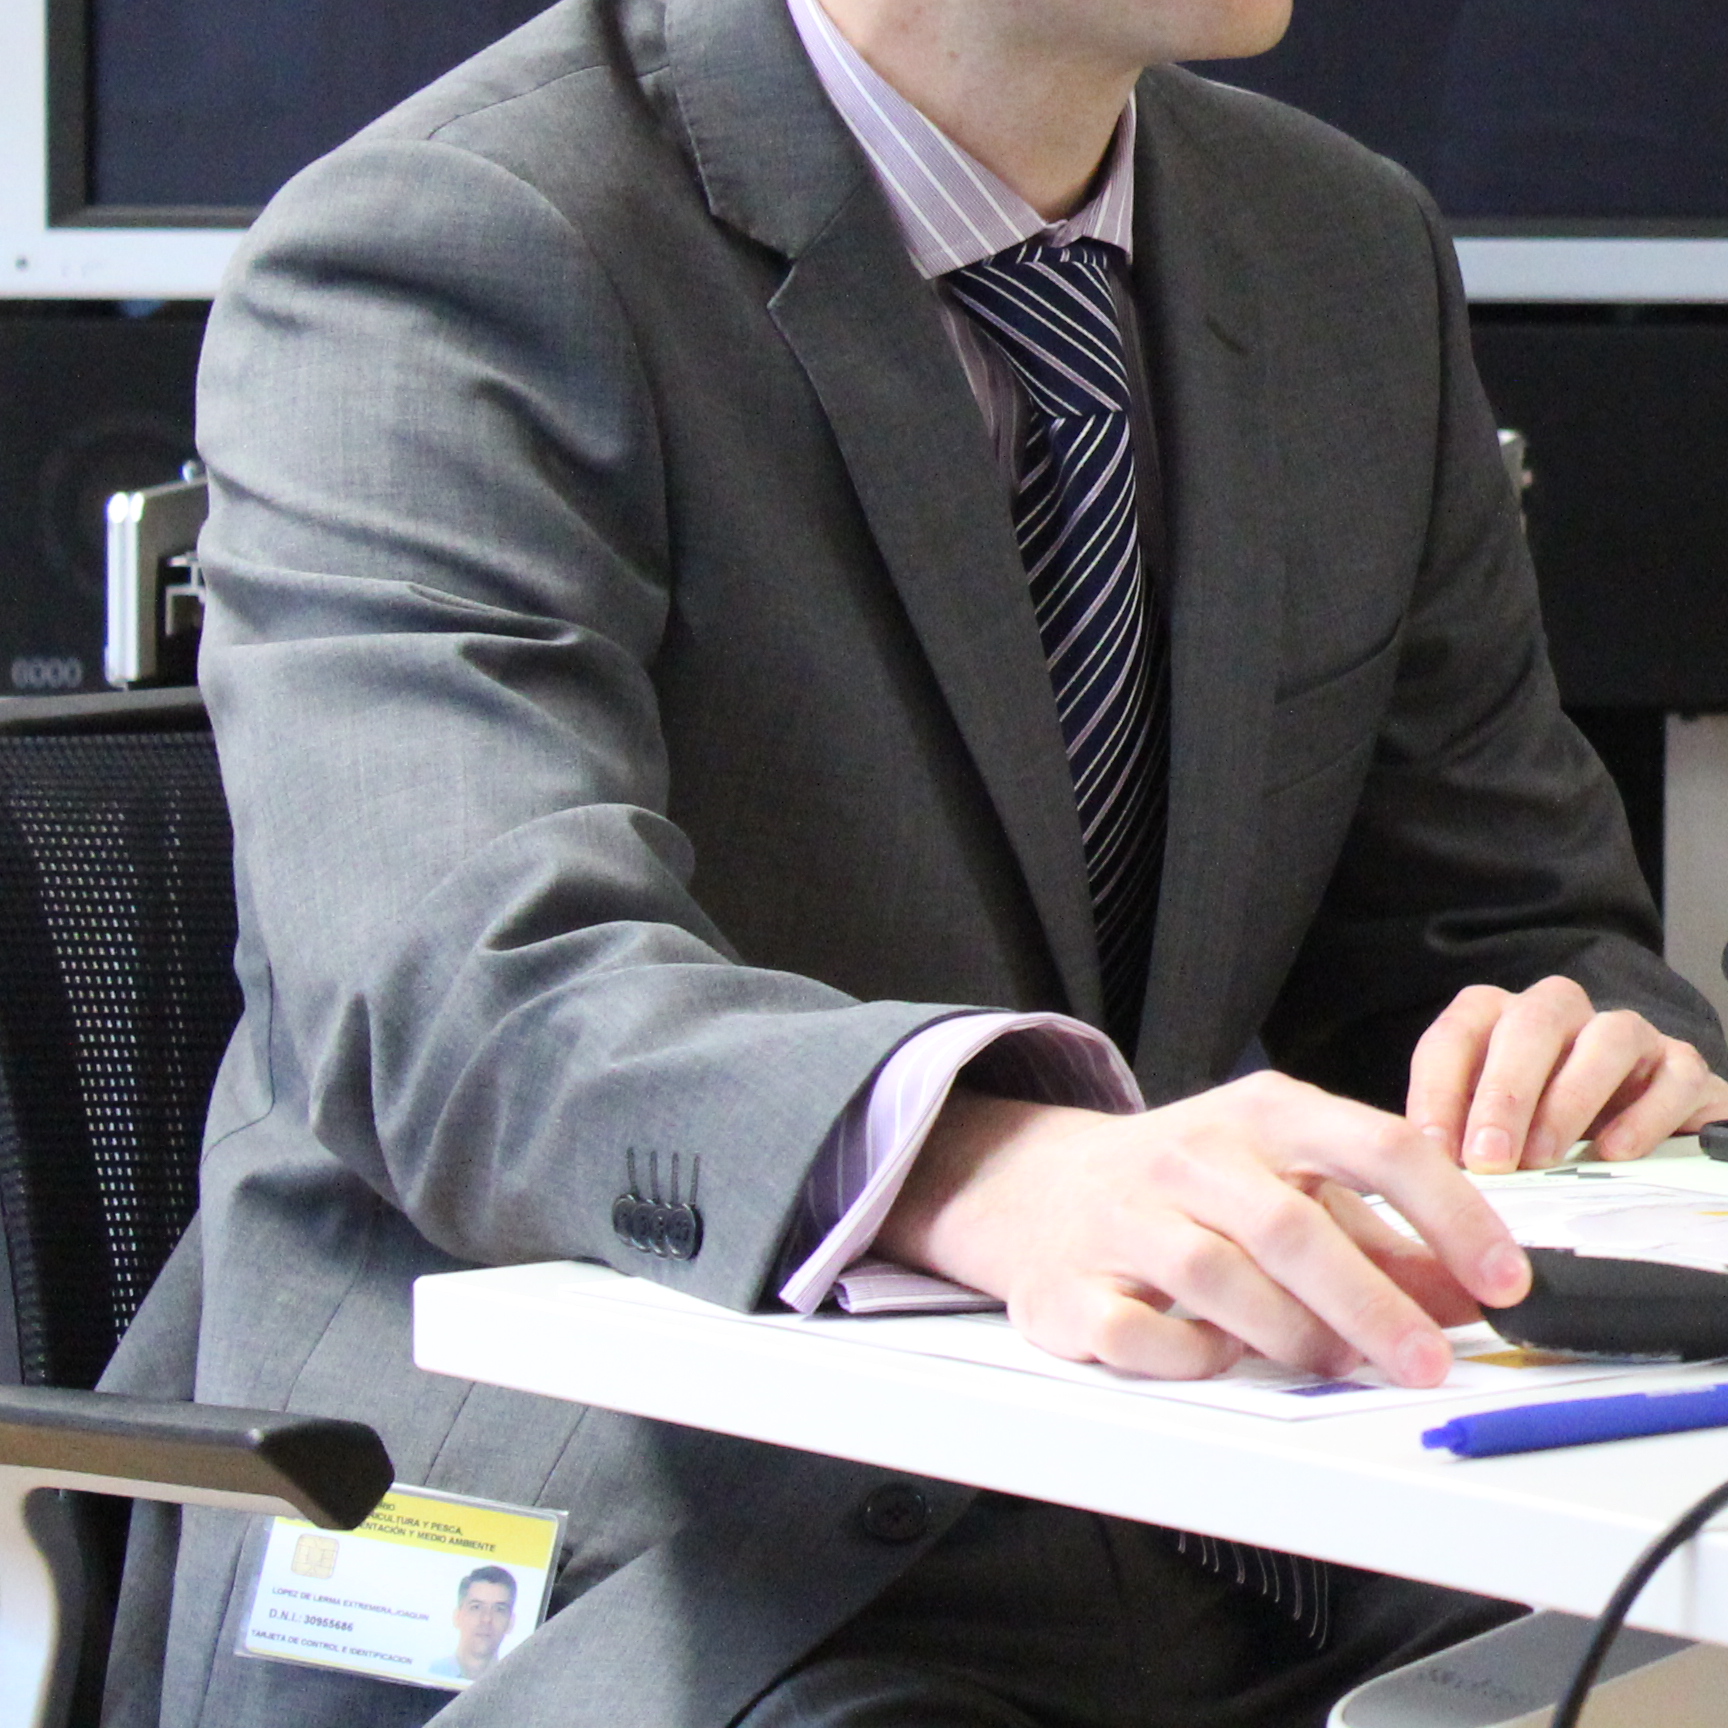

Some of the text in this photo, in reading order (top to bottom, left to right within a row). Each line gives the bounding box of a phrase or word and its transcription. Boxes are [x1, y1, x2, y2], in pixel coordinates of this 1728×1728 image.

[370, 1513, 420, 1528] RICULTURA
[358, 1521, 406, 1536] ENTACIÓN
[416, 1530, 447, 1543] MEDIO
[449, 1536, 496, 1552] AMBIENTE
[300, 1591, 311, 1600] DE
[313, 1595, 341, 1606] LERMA
[251, 1629, 287, 1643] TARJETA
[287, 1635, 299, 1645] DE
[300, 1638, 340, 1652] CONTROL
[341, 1646, 348, 1654] E
